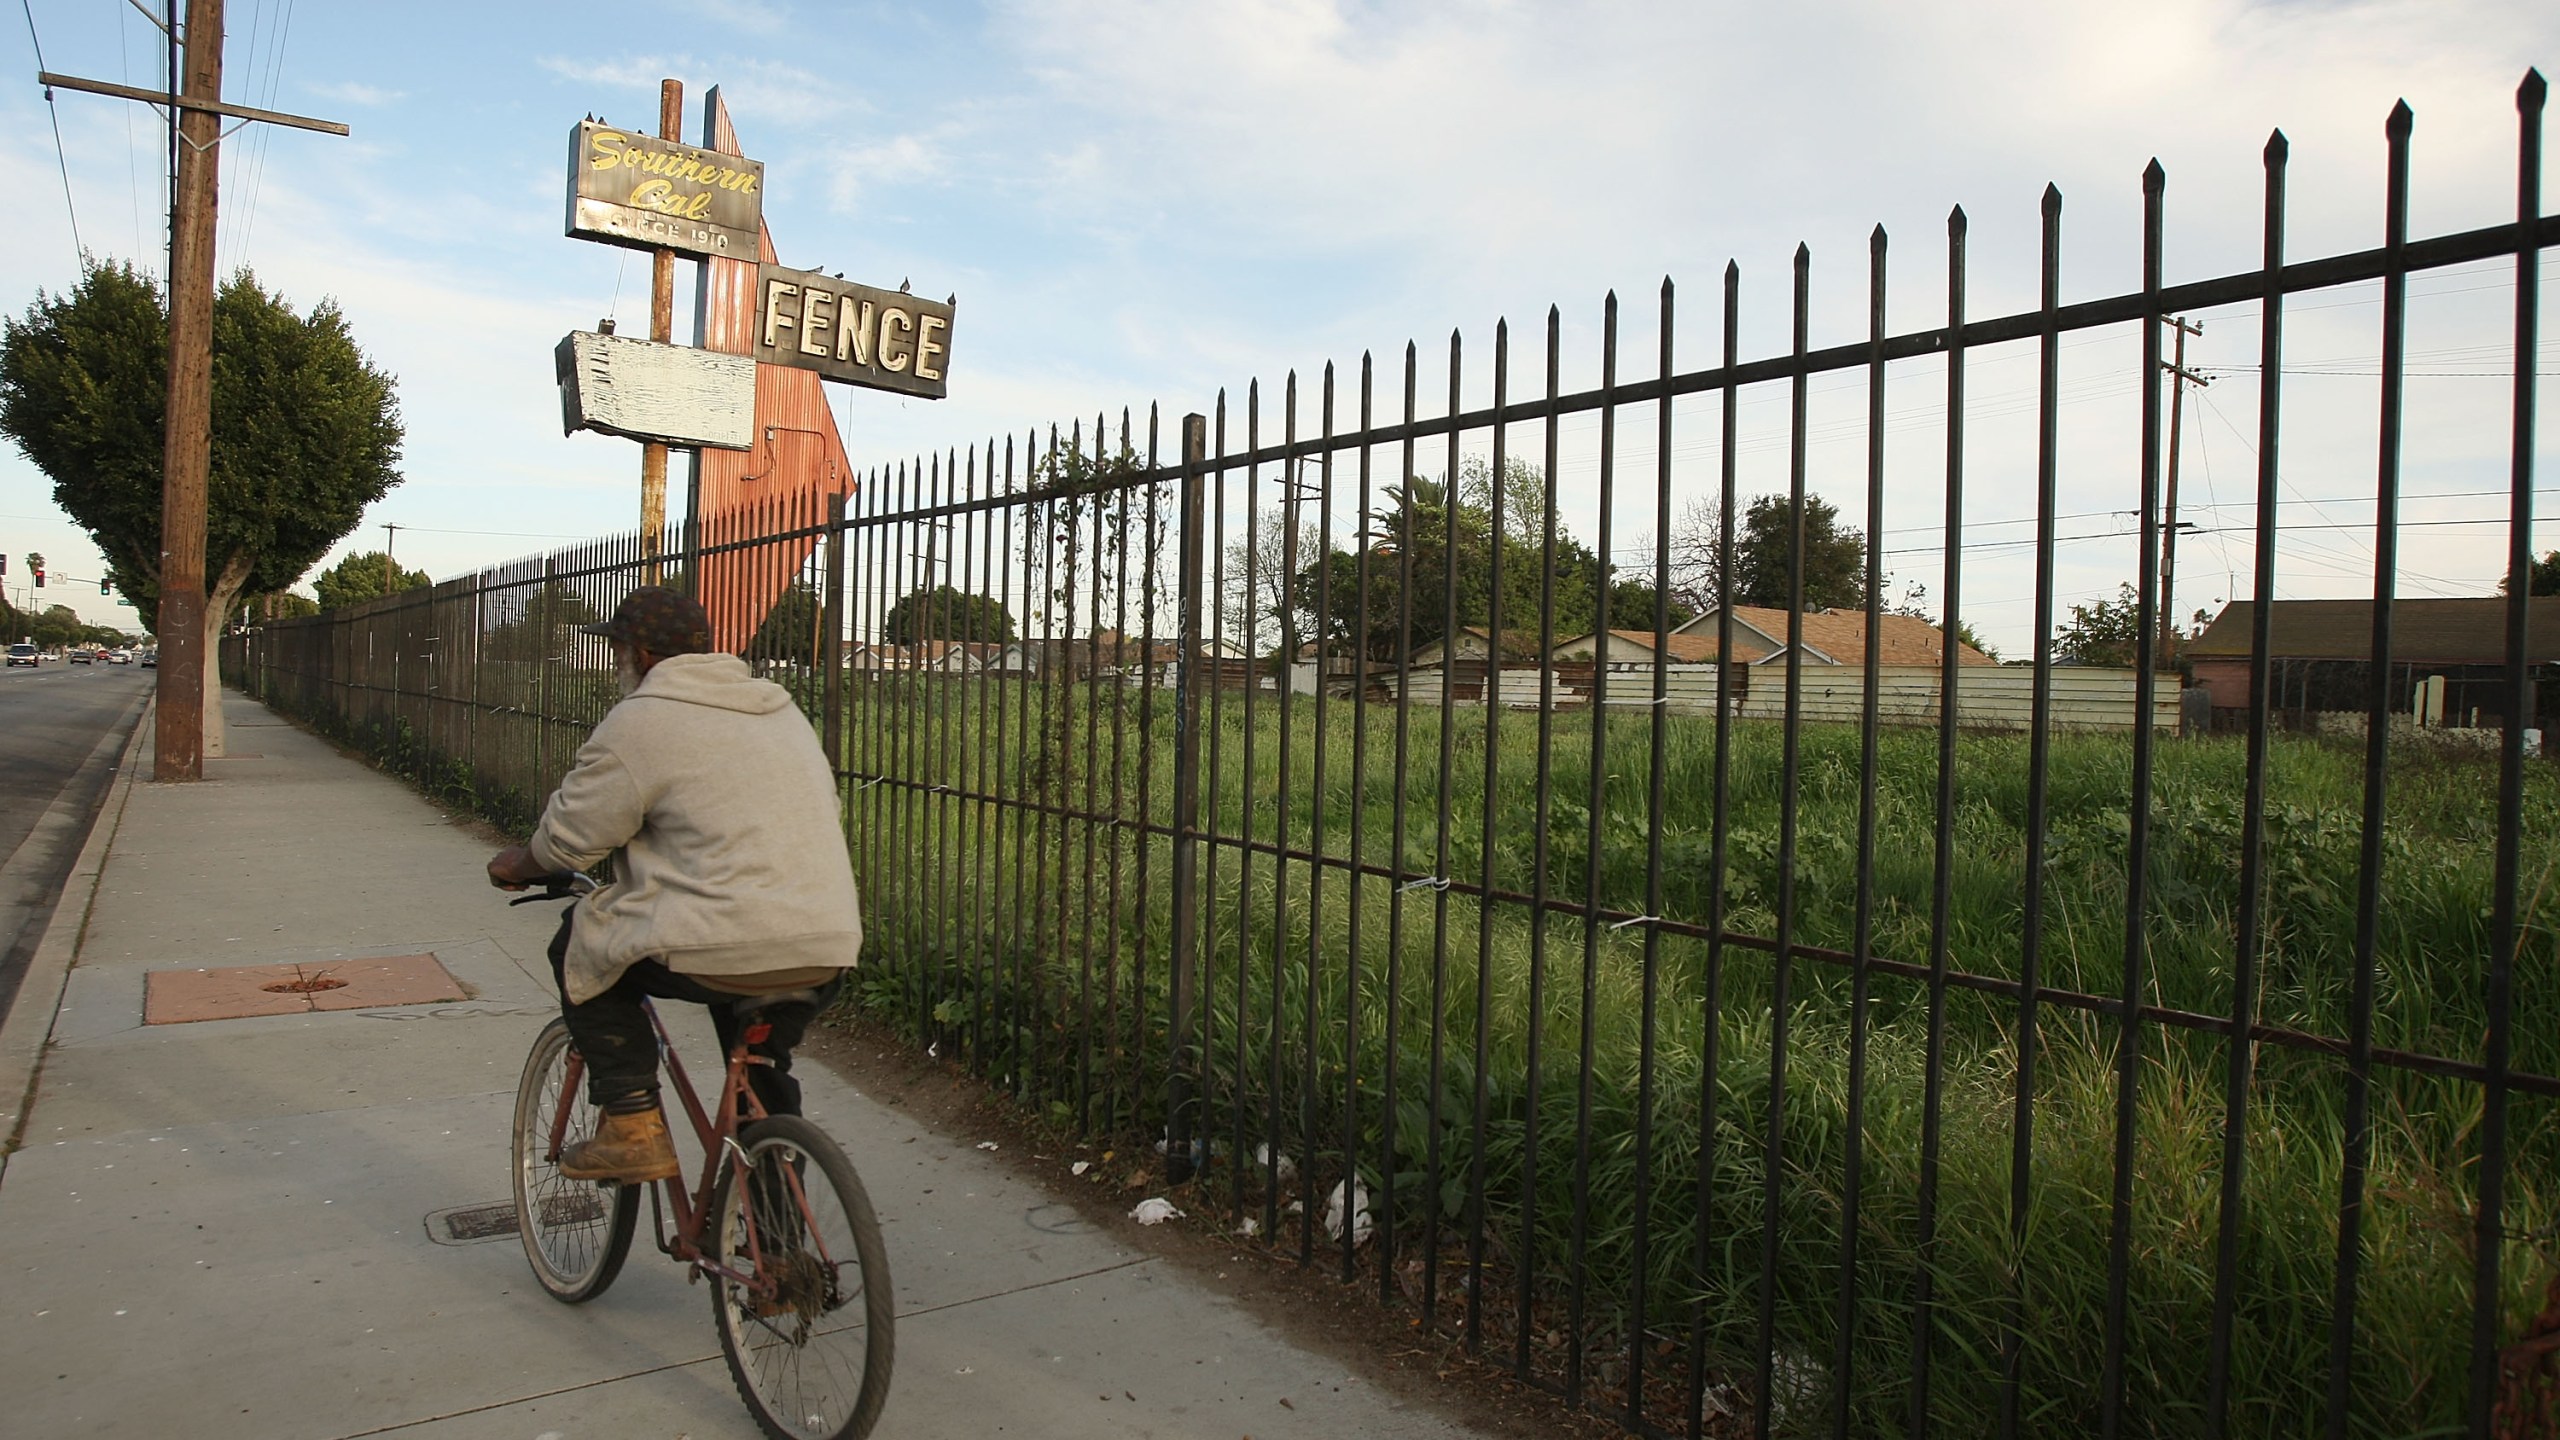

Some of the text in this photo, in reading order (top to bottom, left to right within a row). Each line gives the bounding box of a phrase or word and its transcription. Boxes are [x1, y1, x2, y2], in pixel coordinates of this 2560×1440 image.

[591, 131, 759, 195] Southern
[629, 179, 712, 220] Cal
[691, 229, 729, 250] 1910
[764, 279, 947, 381] FENCE
